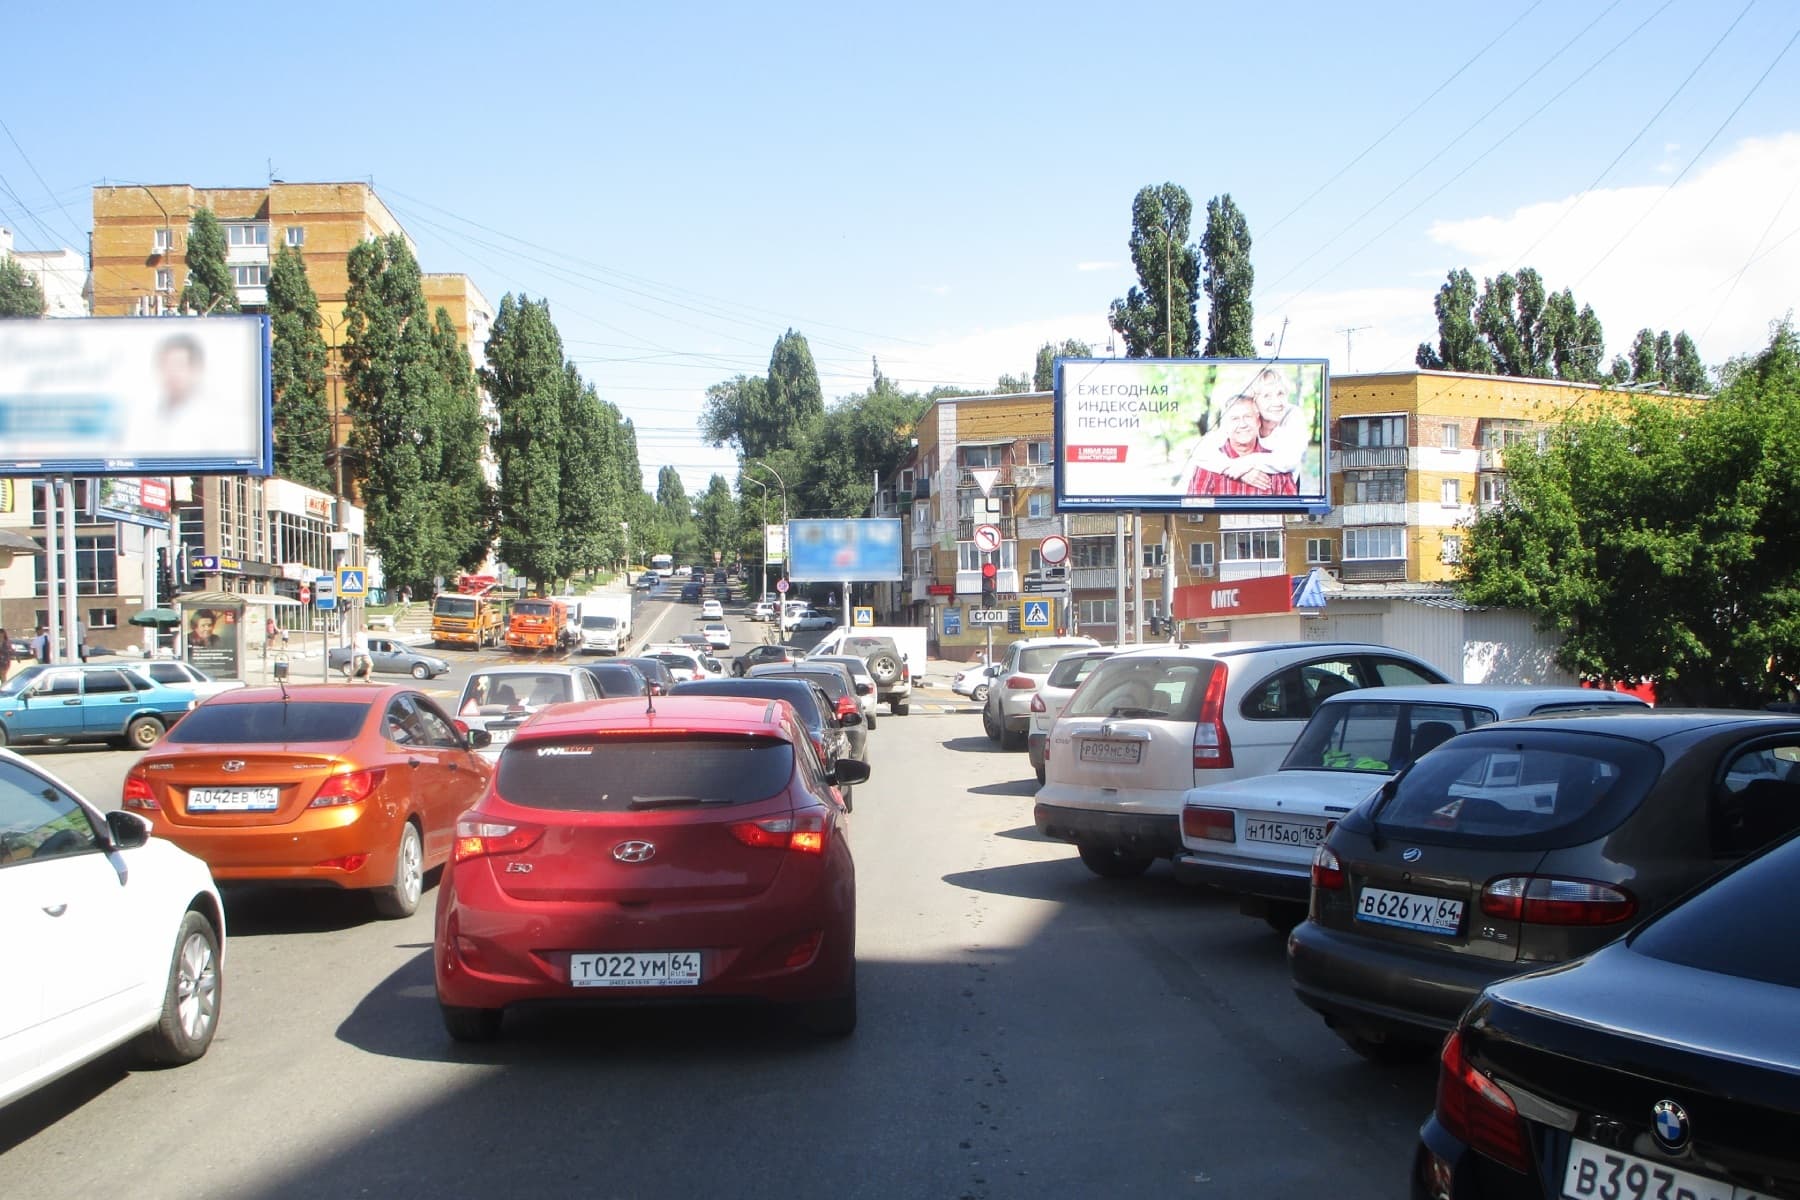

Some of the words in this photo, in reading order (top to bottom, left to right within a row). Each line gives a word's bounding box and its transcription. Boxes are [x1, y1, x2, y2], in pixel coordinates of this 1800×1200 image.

[1078, 384, 1168, 398] ЕЖЕГОДНАЯ
[1078, 401, 1179, 413] ИНДЕКСАЦИЯ
[1078, 414, 1140, 428] ПЕНСИЙ
[1217, 588, 1240, 608] МТС
[974, 612, 1002, 621] СТОП
[194, 790, 249, 803] А042ЕВ
[254, 788, 274, 800] 164
[1250, 823, 1299, 843] Н115АО
[1302, 827, 1322, 841] 163
[1364, 893, 1433, 923] В626УХ
[1438, 900, 1457, 920] 64
[580, 956, 666, 977] Т022УМ
[671, 955, 693, 971] 64
